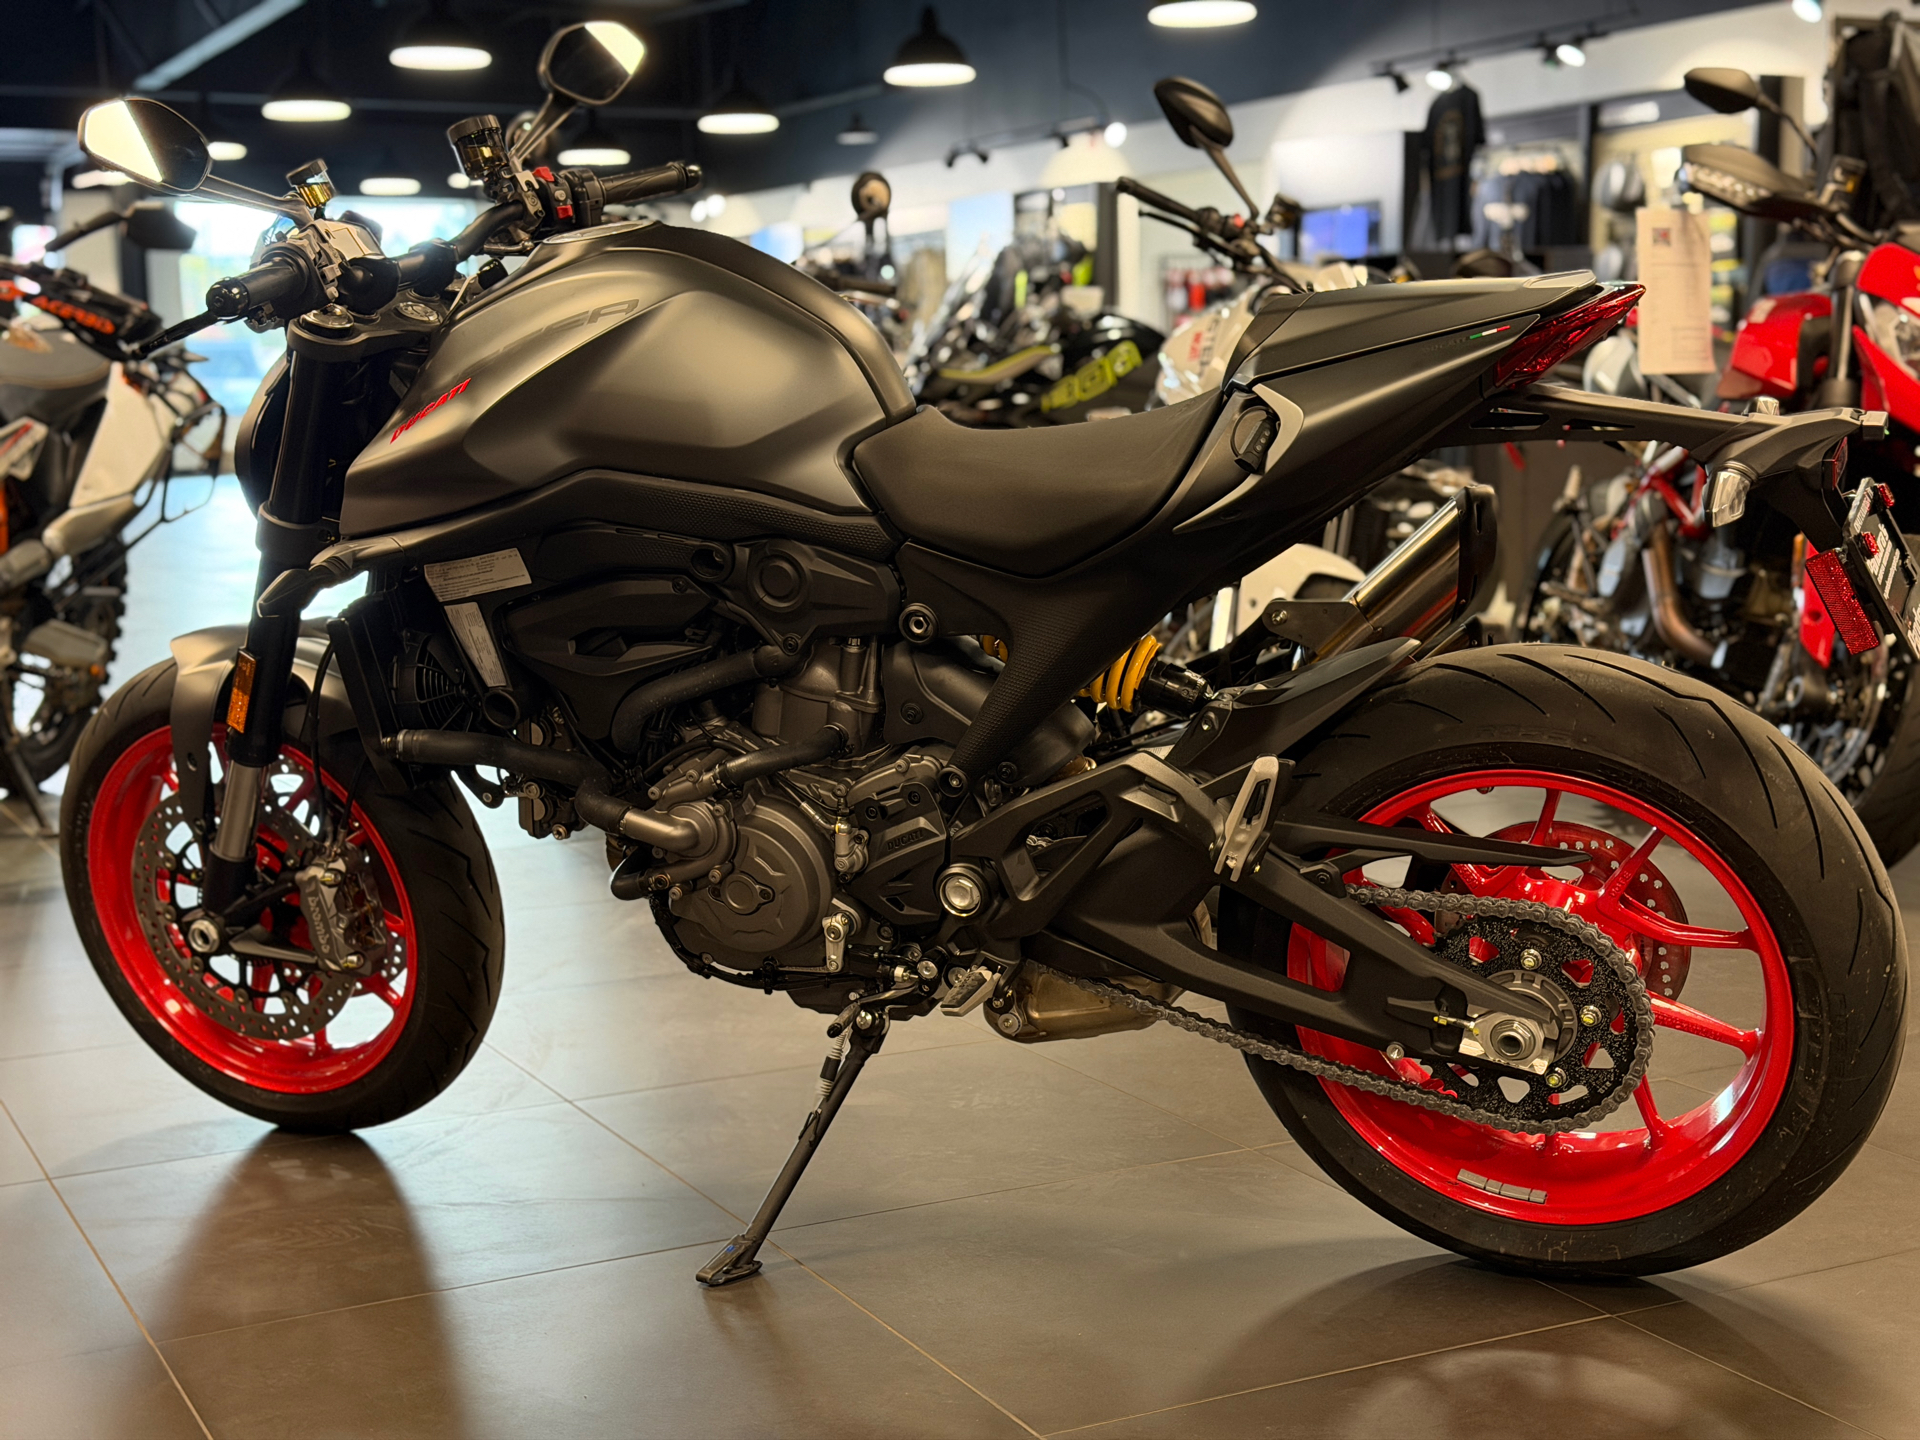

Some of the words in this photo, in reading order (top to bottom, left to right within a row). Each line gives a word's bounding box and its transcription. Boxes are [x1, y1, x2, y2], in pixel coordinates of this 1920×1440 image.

[390, 377, 472, 444] DUCATI
[887, 830, 924, 851] DUCATI
[307, 896, 331, 954] brembo
